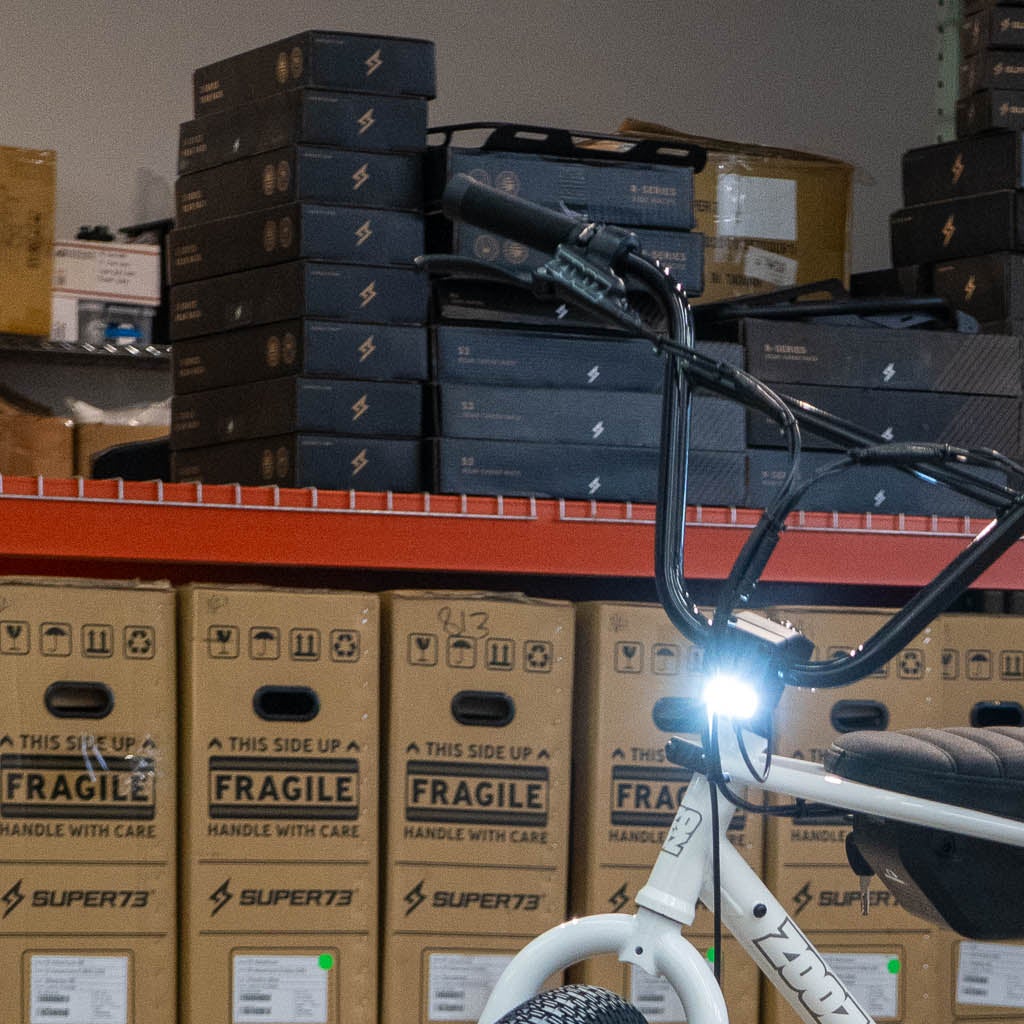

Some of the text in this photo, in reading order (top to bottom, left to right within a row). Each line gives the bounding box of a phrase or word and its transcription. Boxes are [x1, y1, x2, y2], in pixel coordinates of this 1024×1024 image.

[20, 734, 136, 751] THIS SIDE UP
[229, 736, 341, 753] THIS SIDE UP
[426, 741, 532, 760] THIS SIDE UP
[631, 747, 665, 763] THIS
[7, 773, 148, 801] FRAGILE
[215, 775, 353, 802] FRAGILE
[413, 778, 543, 809] FRAGILE
[0, 823, 156, 839] HANDLE WITH CARE
[208, 823, 360, 839] HANDLE WITH CARE
[404, 826, 548, 845] HANDLE WITH CARE
[31, 890, 149, 908] SUPER73
[239, 889, 353, 907] SUPER73
[432, 891, 541, 911] SUPER73
